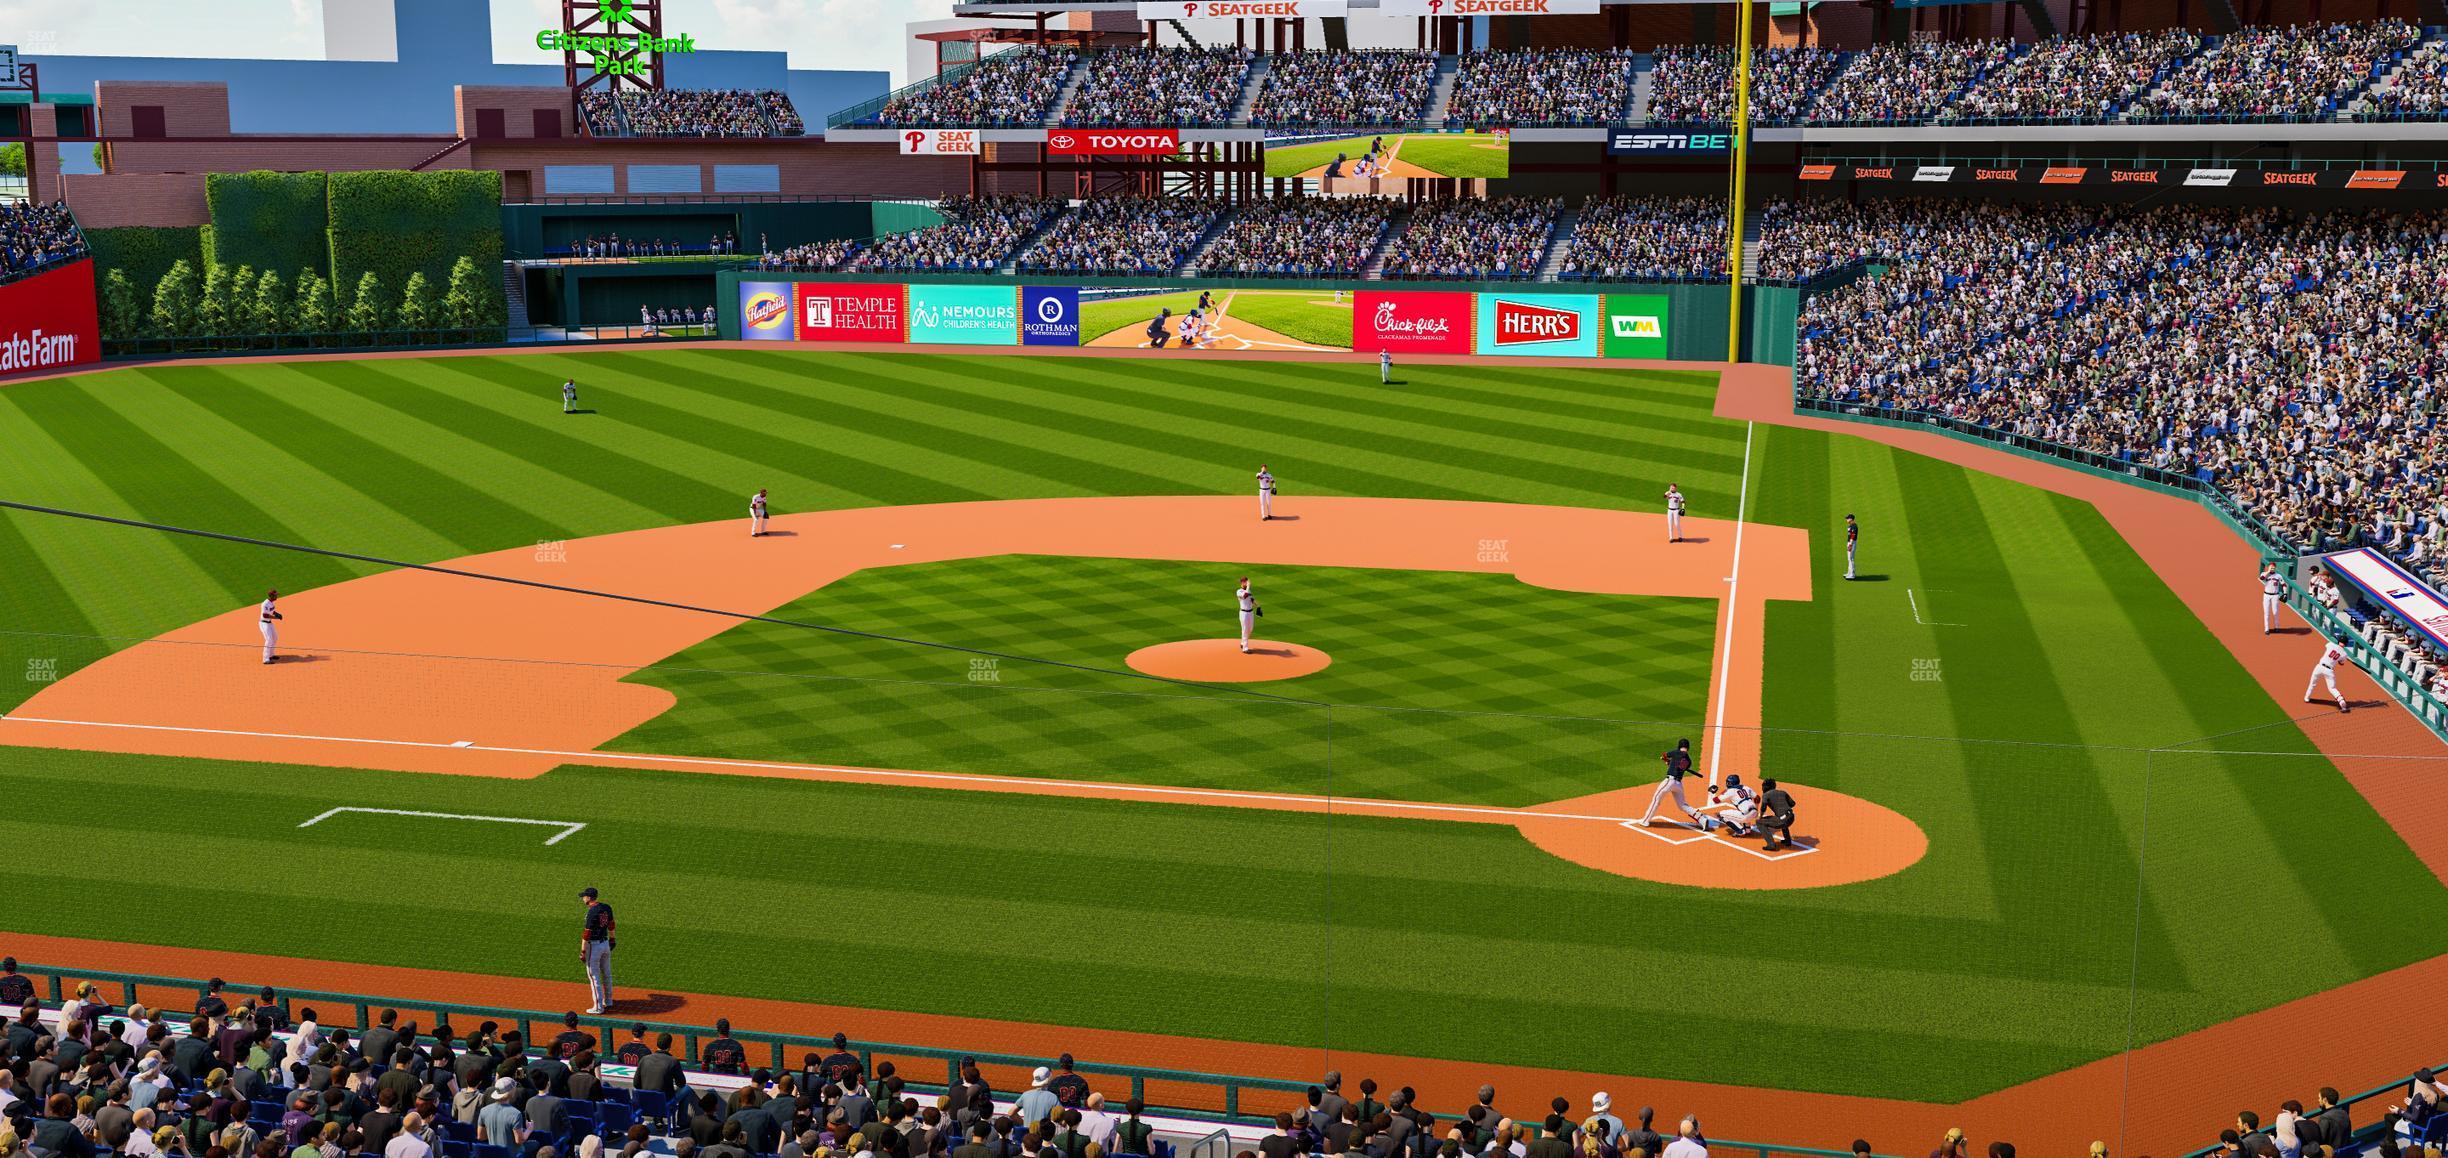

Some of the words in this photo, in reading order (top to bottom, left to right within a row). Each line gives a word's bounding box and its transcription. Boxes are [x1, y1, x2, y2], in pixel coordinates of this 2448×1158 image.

[1208, 2, 1300, 17] SEATGEEK
[1453, 0, 1550, 14] SEATGEEK
[536, 29, 631, 52] Citizens
[637, 33, 696, 54] Bank
[593, 54, 647, 75] Park
[938, 131, 974, 142] SEAT
[1088, 135, 1174, 149] TOYOTA
[1614, 135, 1687, 149] ESPN
[936, 142, 975, 153] GEEK
[1855, 167, 1893, 180] SEATGEEK
[1975, 169, 2018, 181] SEATGEEK
[2111, 170, 2159, 183] SEATGEEK
[2263, 172, 2318, 186] SEATGEEK
[748, 295, 786, 322] Hatfield
[834, 297, 897, 313] TEMPLE
[943, 305, 1015, 319] NEMOURS
[834, 314, 897, 330] HEALTH
[943, 319, 986, 329] CHILDREN'S
[988, 320, 1015, 329] HEALTH
[1374, 302, 1450, 335] Chick-fil-A
[1502, 312, 1571, 337] HERR'S
[1024, 323, 1078, 333] ROTHMAN
[1618, 320, 1655, 333] WM
